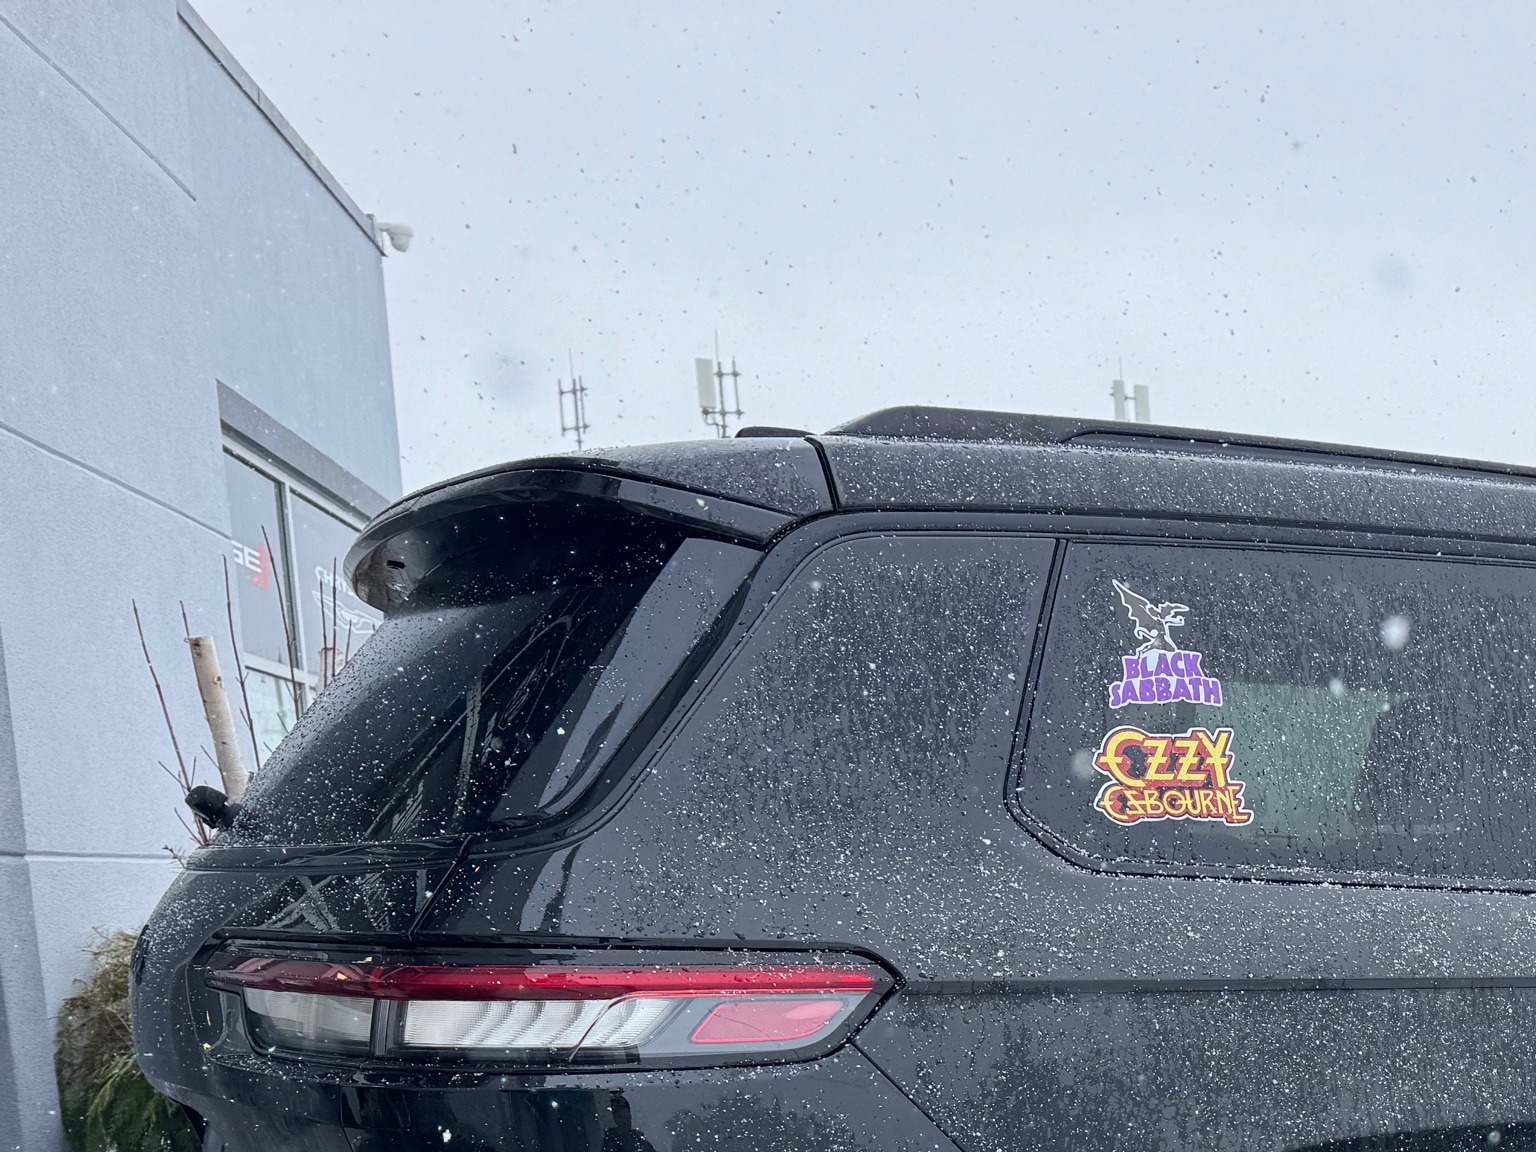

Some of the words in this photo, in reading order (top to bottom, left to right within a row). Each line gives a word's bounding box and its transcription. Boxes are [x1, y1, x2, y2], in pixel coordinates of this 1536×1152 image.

[1125, 652, 1202, 679] BLACK
[1110, 678, 1222, 706] SABBATH
[1098, 730, 1231, 788] OZZY
[1099, 785, 1250, 821] OSBOURNE
